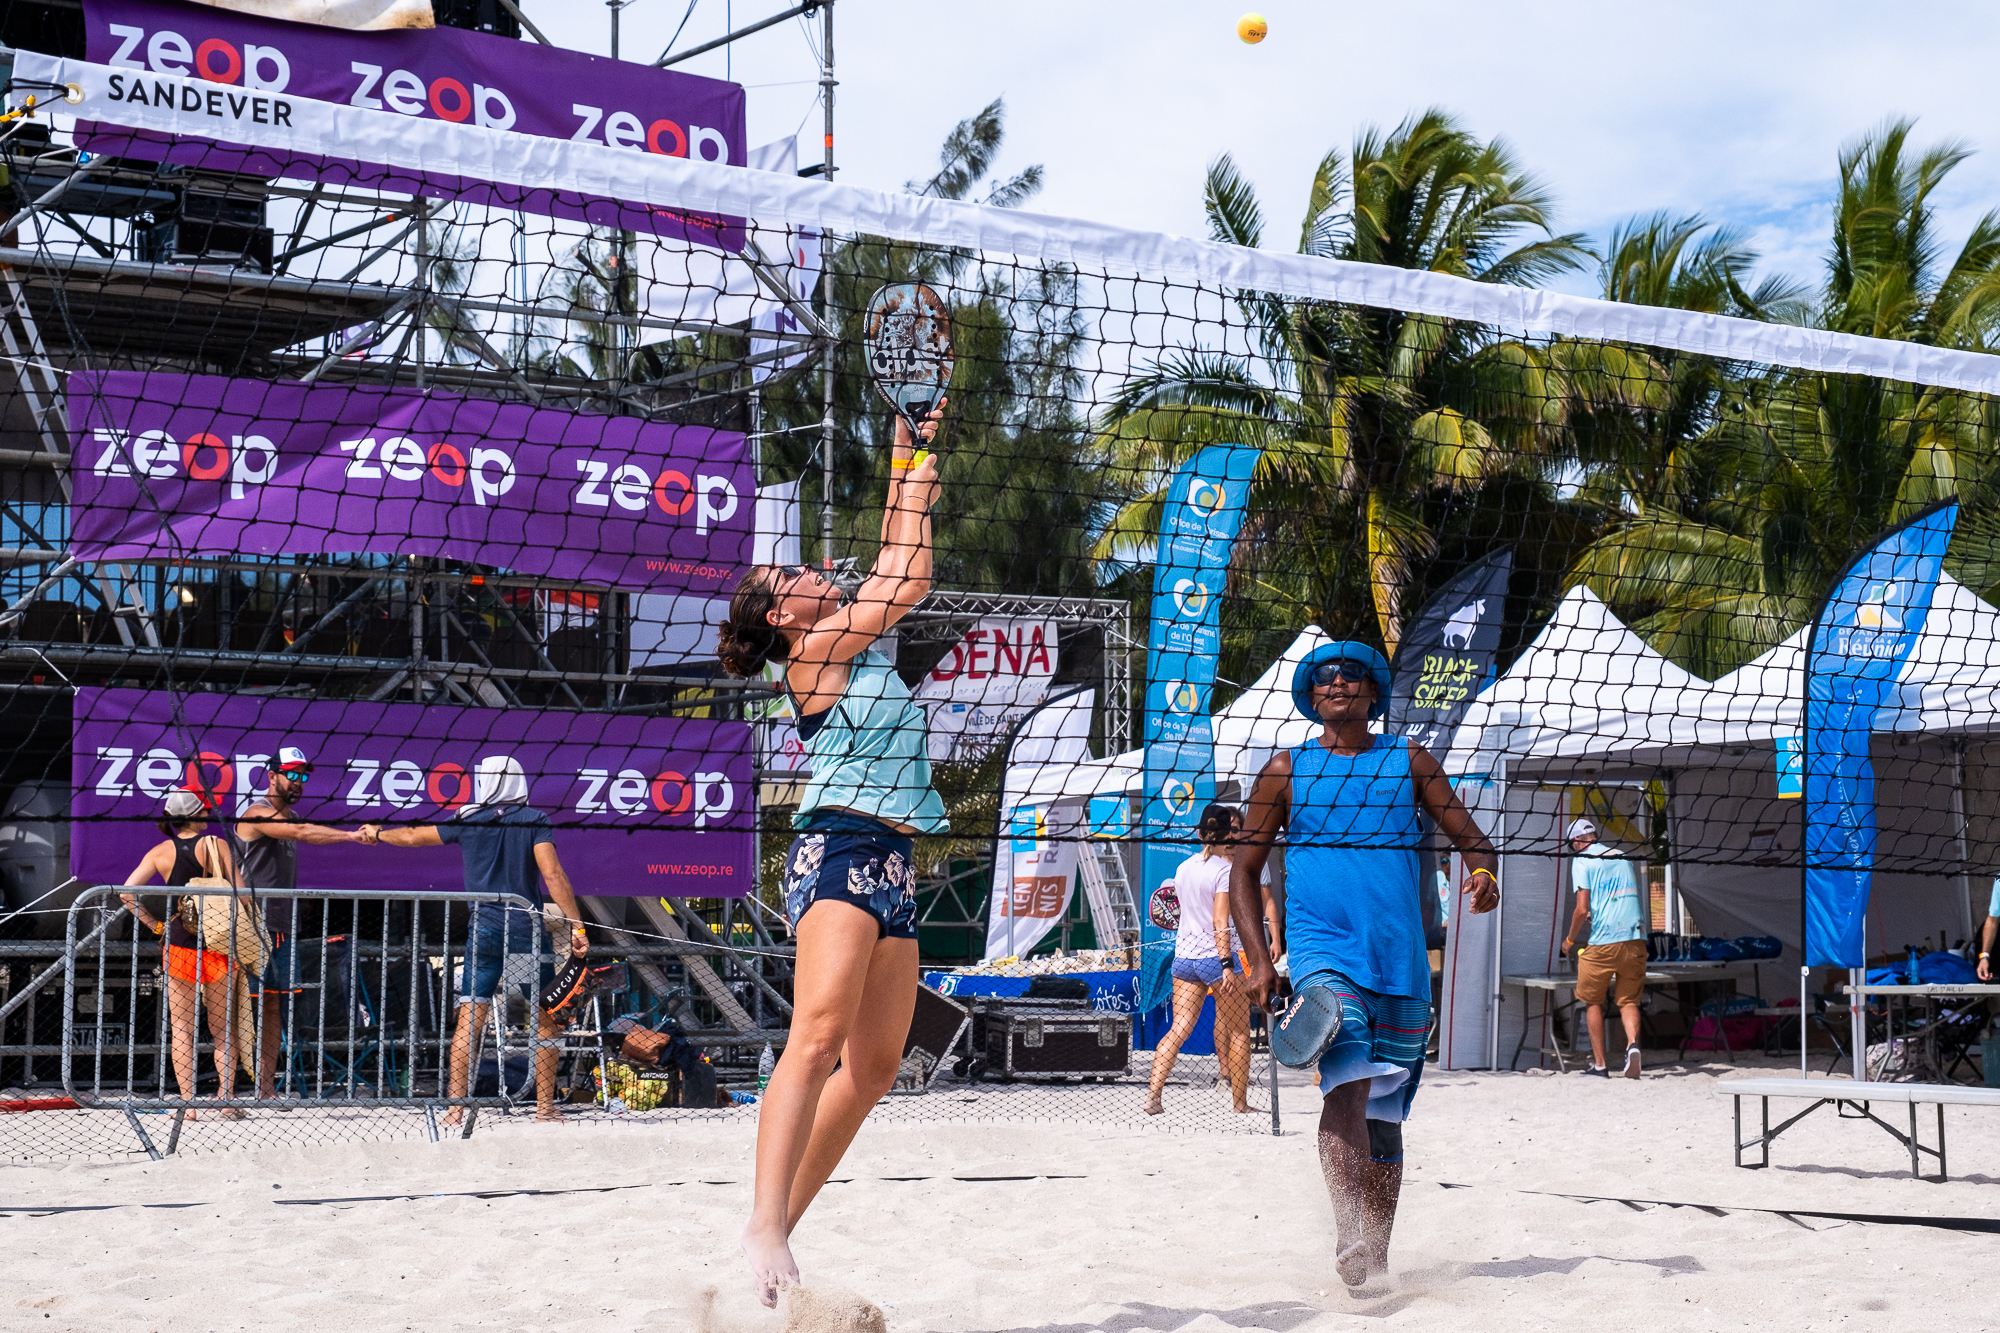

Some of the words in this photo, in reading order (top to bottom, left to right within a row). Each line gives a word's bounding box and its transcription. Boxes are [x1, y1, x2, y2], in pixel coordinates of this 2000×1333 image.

[109, 23, 290, 93] zeop
[108, 74, 292, 128] SANDEVER
[350, 61, 516, 131] zeop
[570, 103, 729, 166] zeop
[92, 427, 278, 500] zeop
[342, 435, 516, 505] zeop
[575, 458, 738, 535] zeop
[646, 558, 733, 580] www.zeop.re
[1181, 633, 1205, 646] l'Oest
[1838, 637, 1906, 657] Réunion
[984, 715, 995, 725] DE
[1414, 683, 1468, 711] SHEEP
[1181, 723, 1210, 736] Torisme
[95, 745, 271, 817] zeop
[346, 759, 482, 810] zeo
[575, 767, 734, 834] zeop
[647, 863, 734, 879] www.zeop.re
[1040, 883, 1058, 913] NIS
